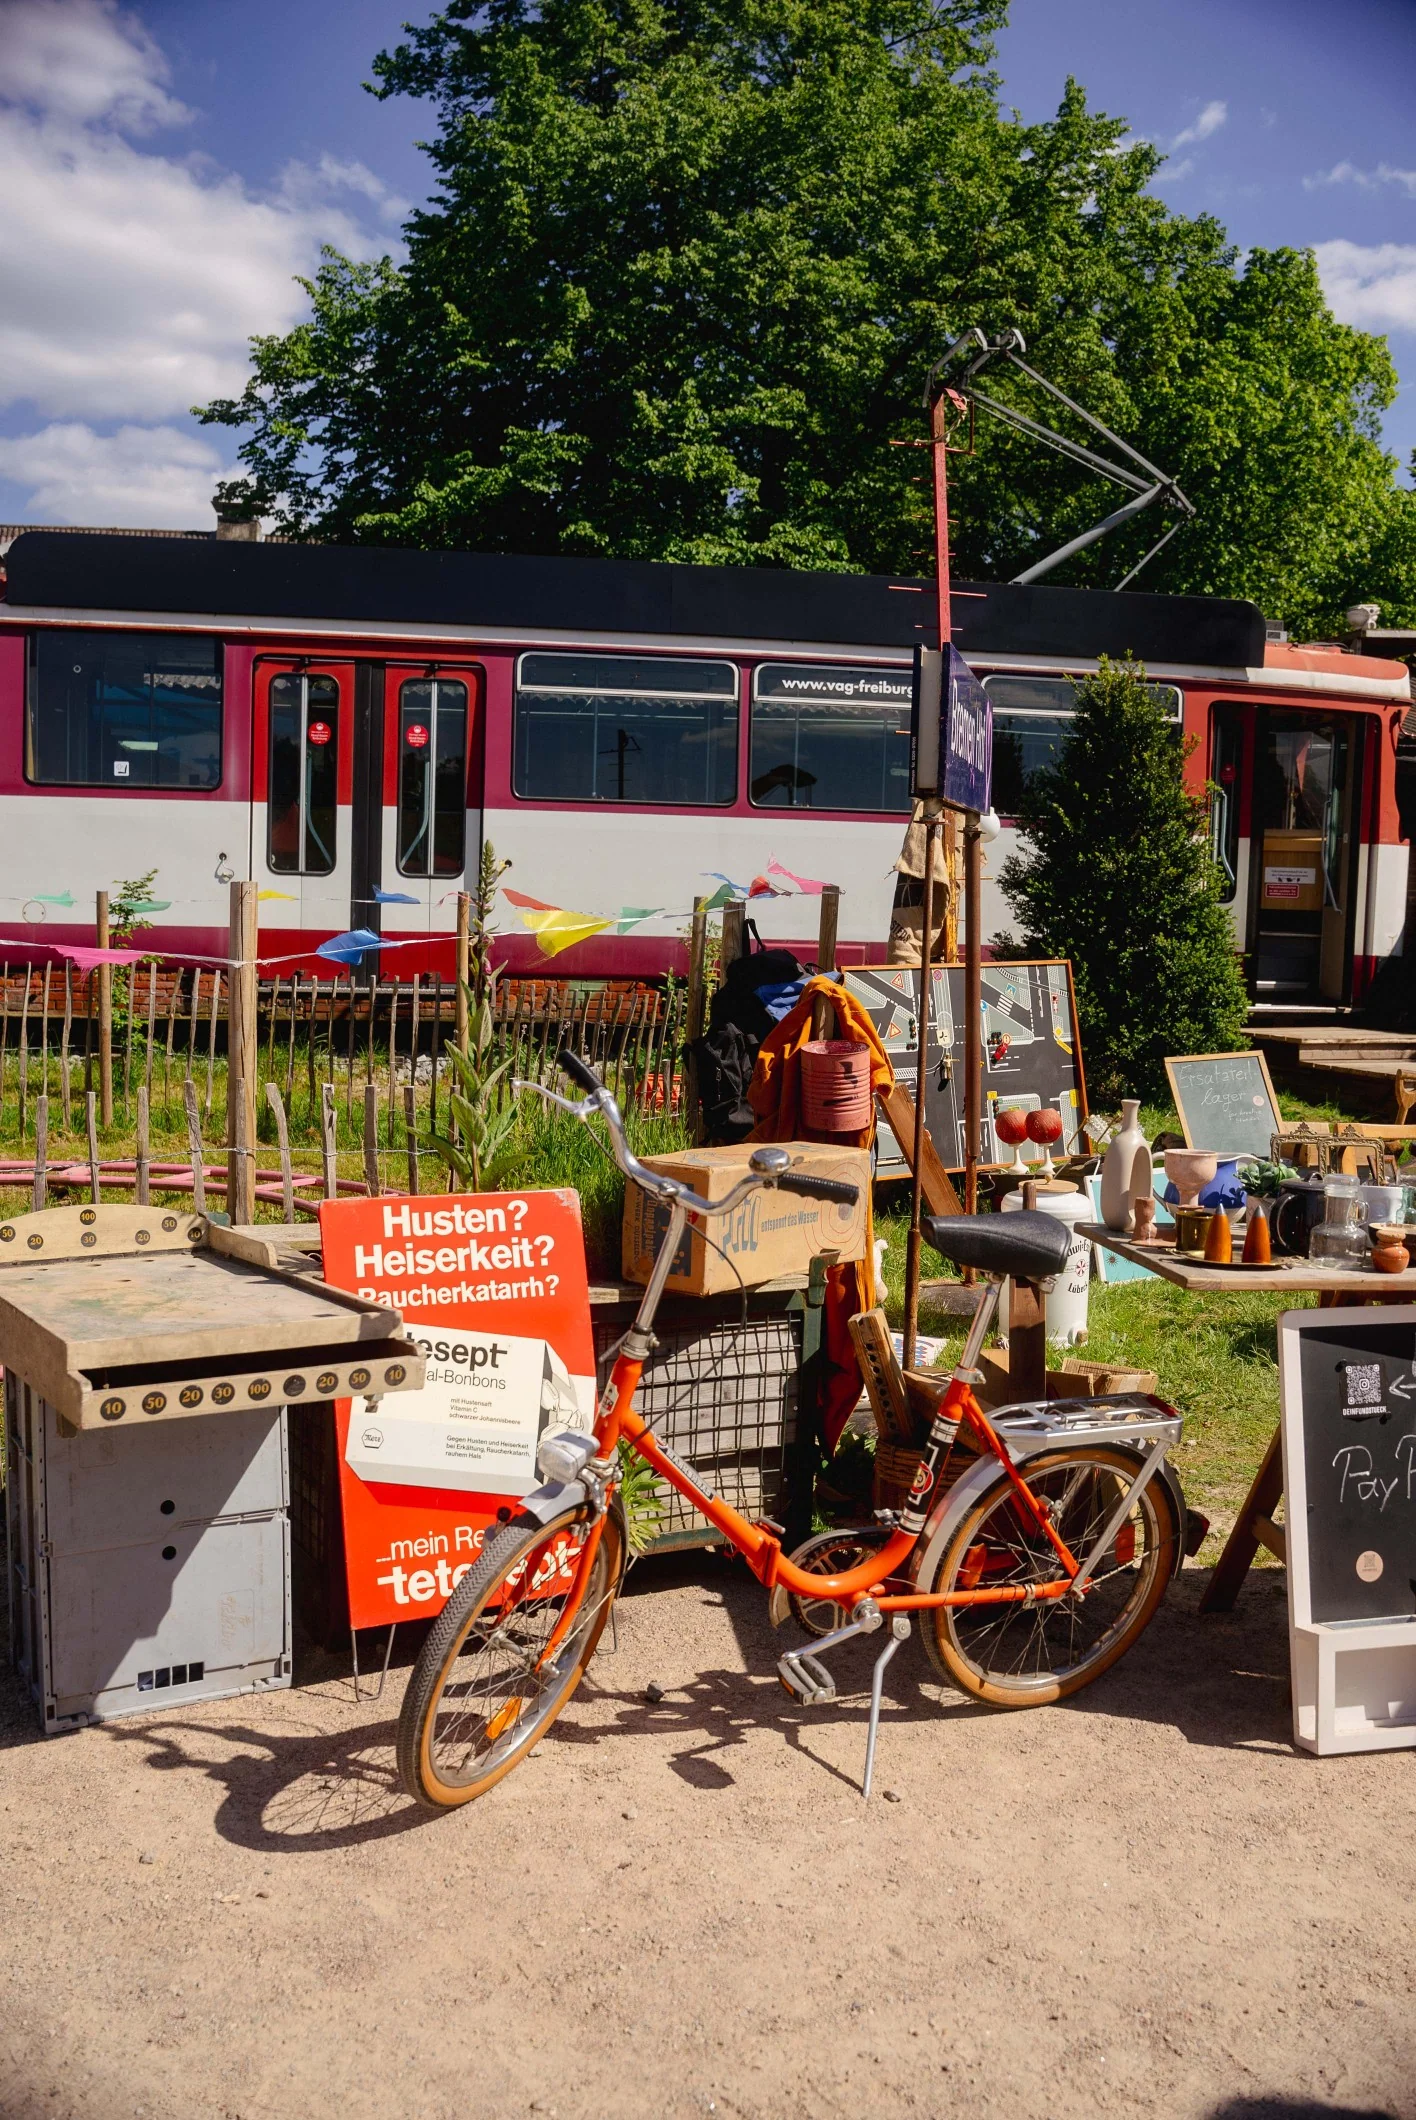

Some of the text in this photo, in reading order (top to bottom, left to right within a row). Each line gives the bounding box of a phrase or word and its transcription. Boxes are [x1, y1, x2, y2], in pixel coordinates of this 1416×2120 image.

[781, 679, 913, 698] www.vag-freiburg
[1201, 1087, 1247, 1112] lager
[80, 1212, 96, 1220] 100
[163, 1219, 176, 1227] 50
[383, 1200, 528, 1238] Husten?
[788, 1212, 797, 1226] das
[798, 1210, 819, 1225] Wasser
[1, 1228, 14, 1237] 50
[83, 1234, 95, 1243] 30
[137, 1233, 150, 1241] 20
[189, 1230, 202, 1238] 10
[30, 1236, 42, 1245] 20
[354, 1235, 555, 1278] Heiserkeit?
[426, 1368, 506, 1390] al-Bonbons
[105, 1369, 402, 1414] 10 50 20 30 100 20 50 10
[460, 1398, 492, 1407] Hustensaft
[479, 1415, 521, 1425] Johannisbeere
[446, 1434, 466, 1443] Gegen
[500, 1440, 529, 1449] Heiserkeit
[456, 1443, 486, 1453] Erkältung,
[486, 1447, 532, 1457] Raucherkatarrh,
[455, 1525, 486, 1551] Re
